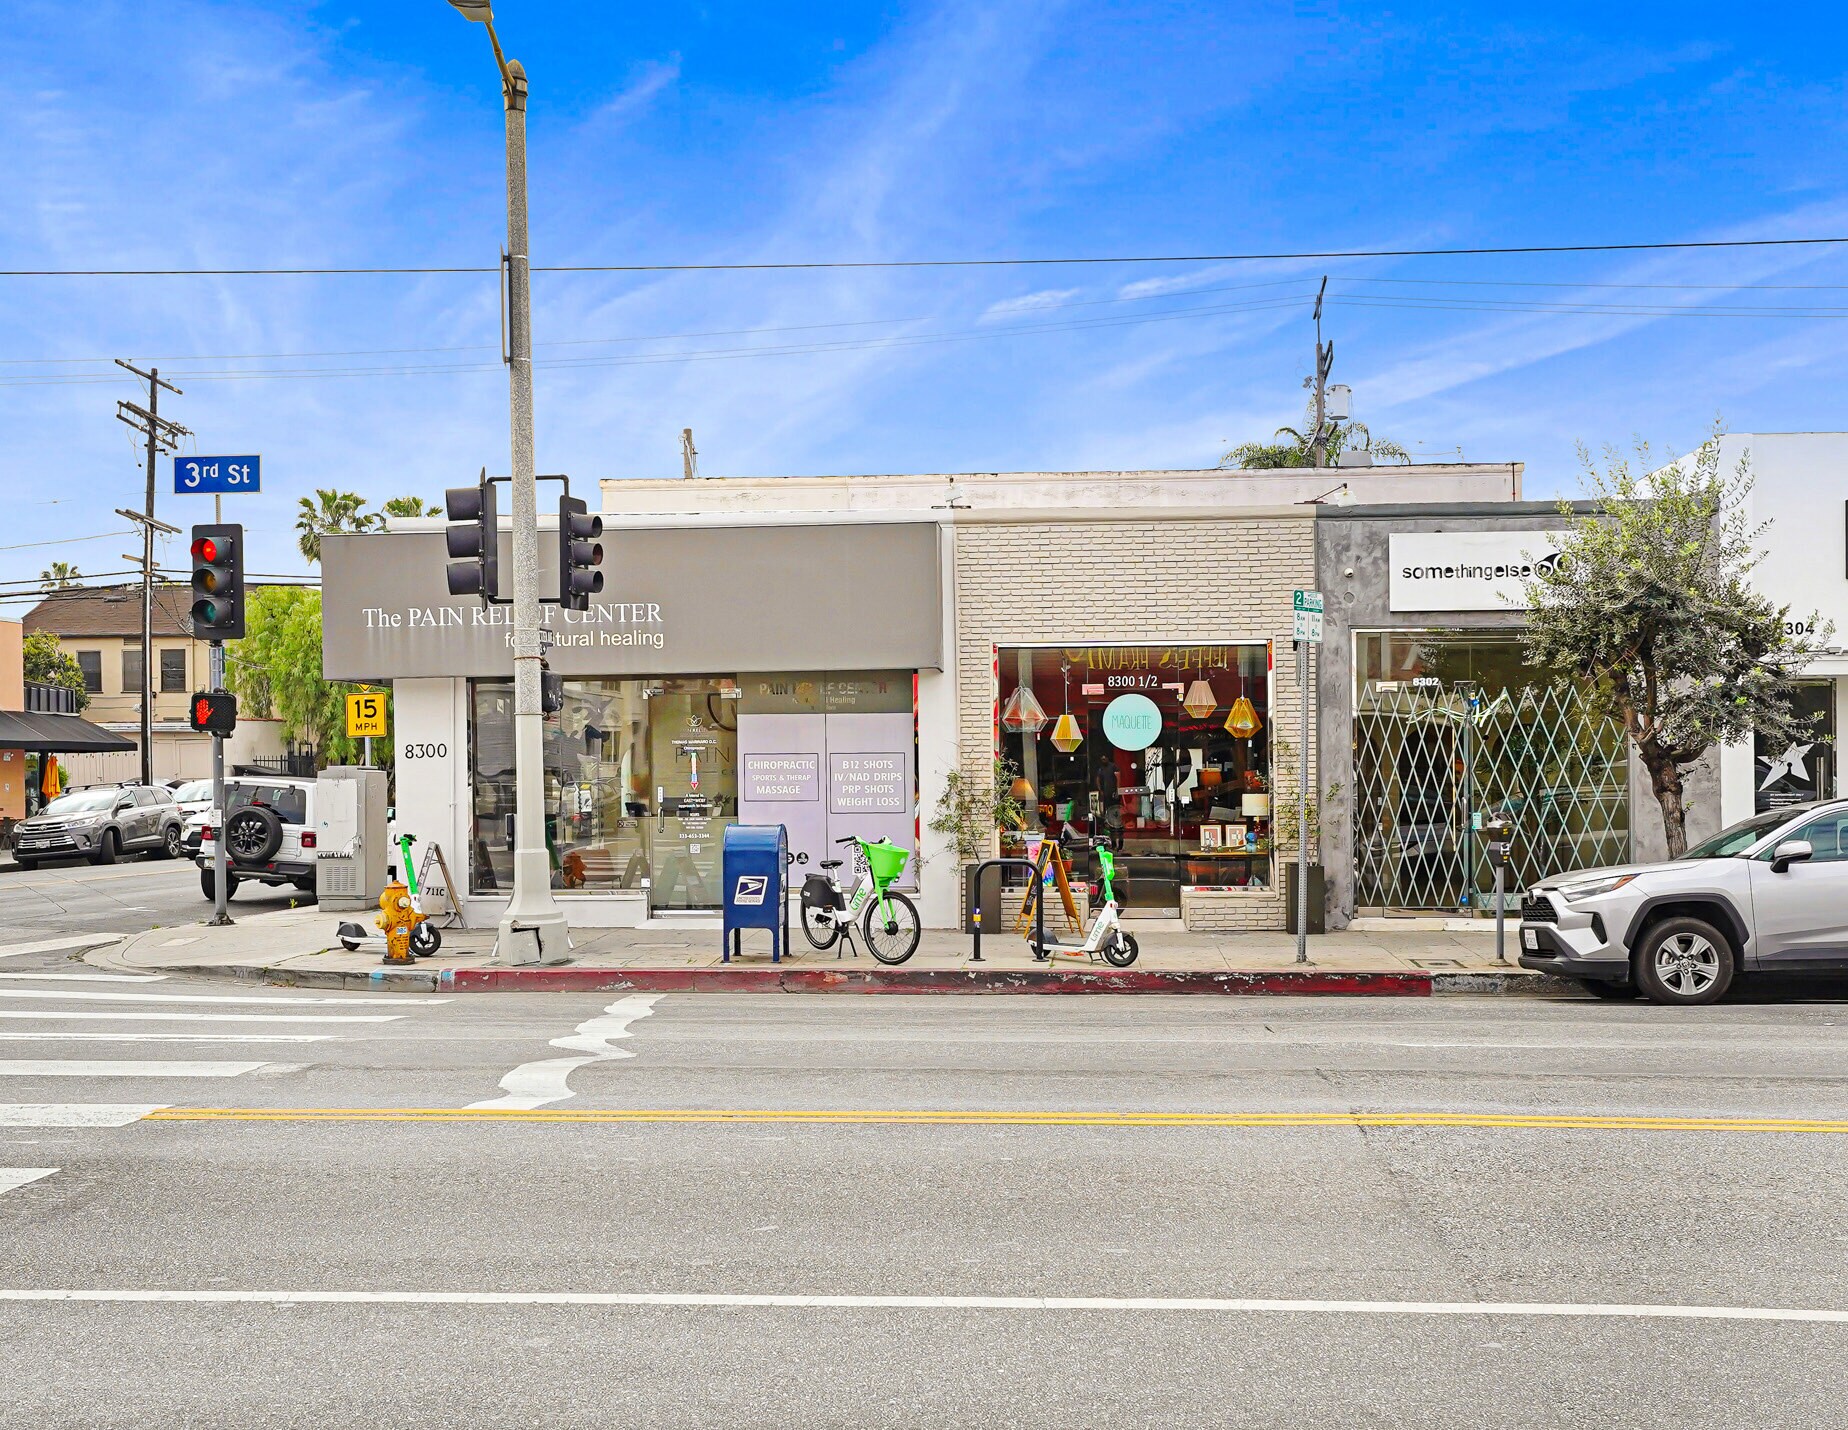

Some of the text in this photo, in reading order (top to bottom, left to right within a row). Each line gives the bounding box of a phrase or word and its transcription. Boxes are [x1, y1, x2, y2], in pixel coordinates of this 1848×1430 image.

[184, 462, 250, 487] 3rd St
[1402, 563, 1531, 580] somethingelse
[1295, 592, 1302, 605] 2
[362, 603, 663, 628] The PAIN RELF CENTER
[1785, 621, 1815, 635] 304
[552, 631, 594, 648] tural
[600, 630, 664, 649] healing
[1107, 674, 1158, 688] 8300 1/2
[1412, 678, 1440, 686] 8302
[831, 696, 856, 705] Healing
[355, 699, 377, 718] 15
[355, 723, 378, 731] MPH
[1111, 715, 1152, 730] MAQUETTE
[405, 743, 448, 759] 8300
[748, 760, 815, 770] CHIROPRACTIC
[842, 760, 893, 769] B12 SHOTS
[834, 772, 903, 782] IV/NAD DRIPS
[756, 785, 801, 794] MASSAGE
[842, 785, 894, 794] PRP SHOTS
[837, 797, 900, 806] WEIGHT LOSS
[426, 887, 445, 896] 711C
